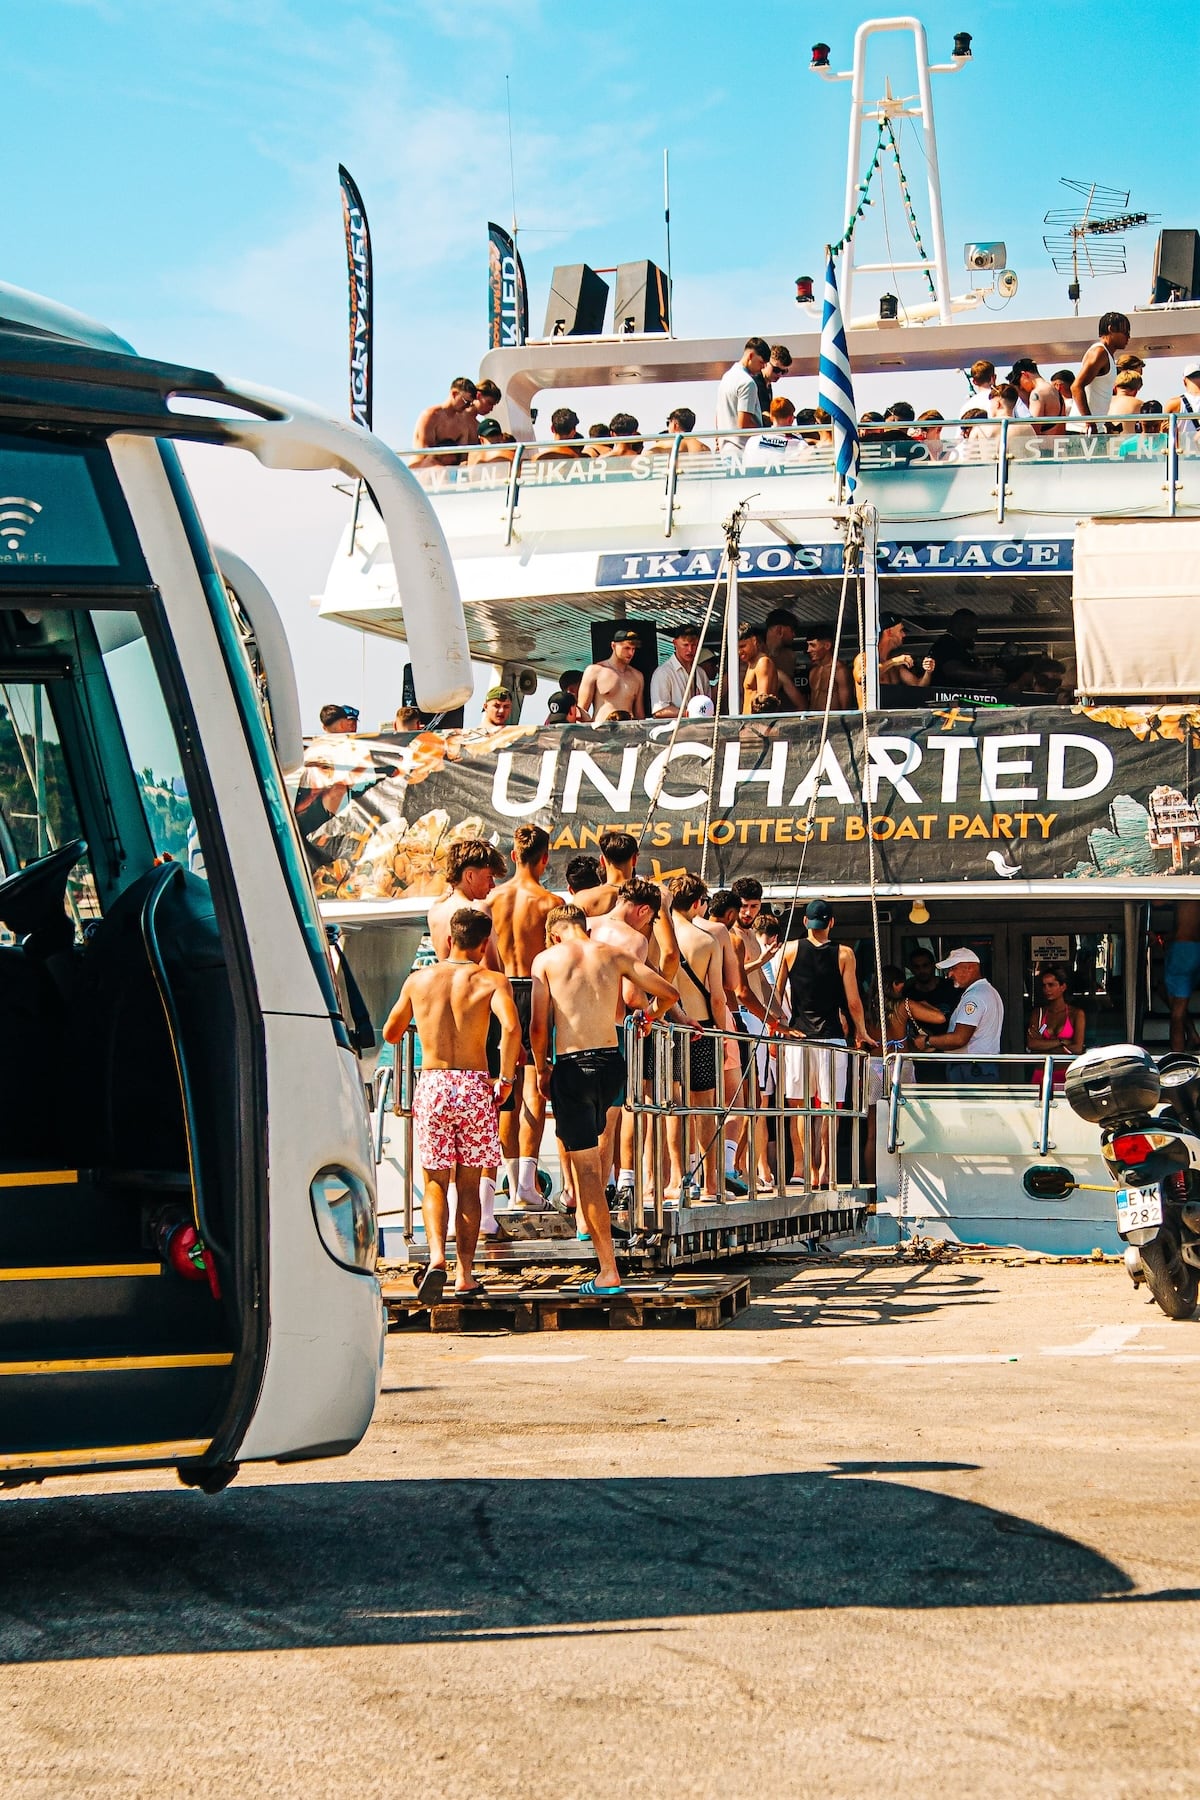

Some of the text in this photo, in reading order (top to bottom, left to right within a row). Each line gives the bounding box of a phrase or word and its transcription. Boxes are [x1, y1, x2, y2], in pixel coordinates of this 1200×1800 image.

[491, 733, 1114, 818] UNCHARTED
[683, 816, 835, 847] HOTTEST
[845, 814, 938, 841] BOAT
[948, 812, 1058, 839] PARTY
[1129, 1188, 1158, 1206] EYK
[1130, 1207, 1160, 1225] 282
